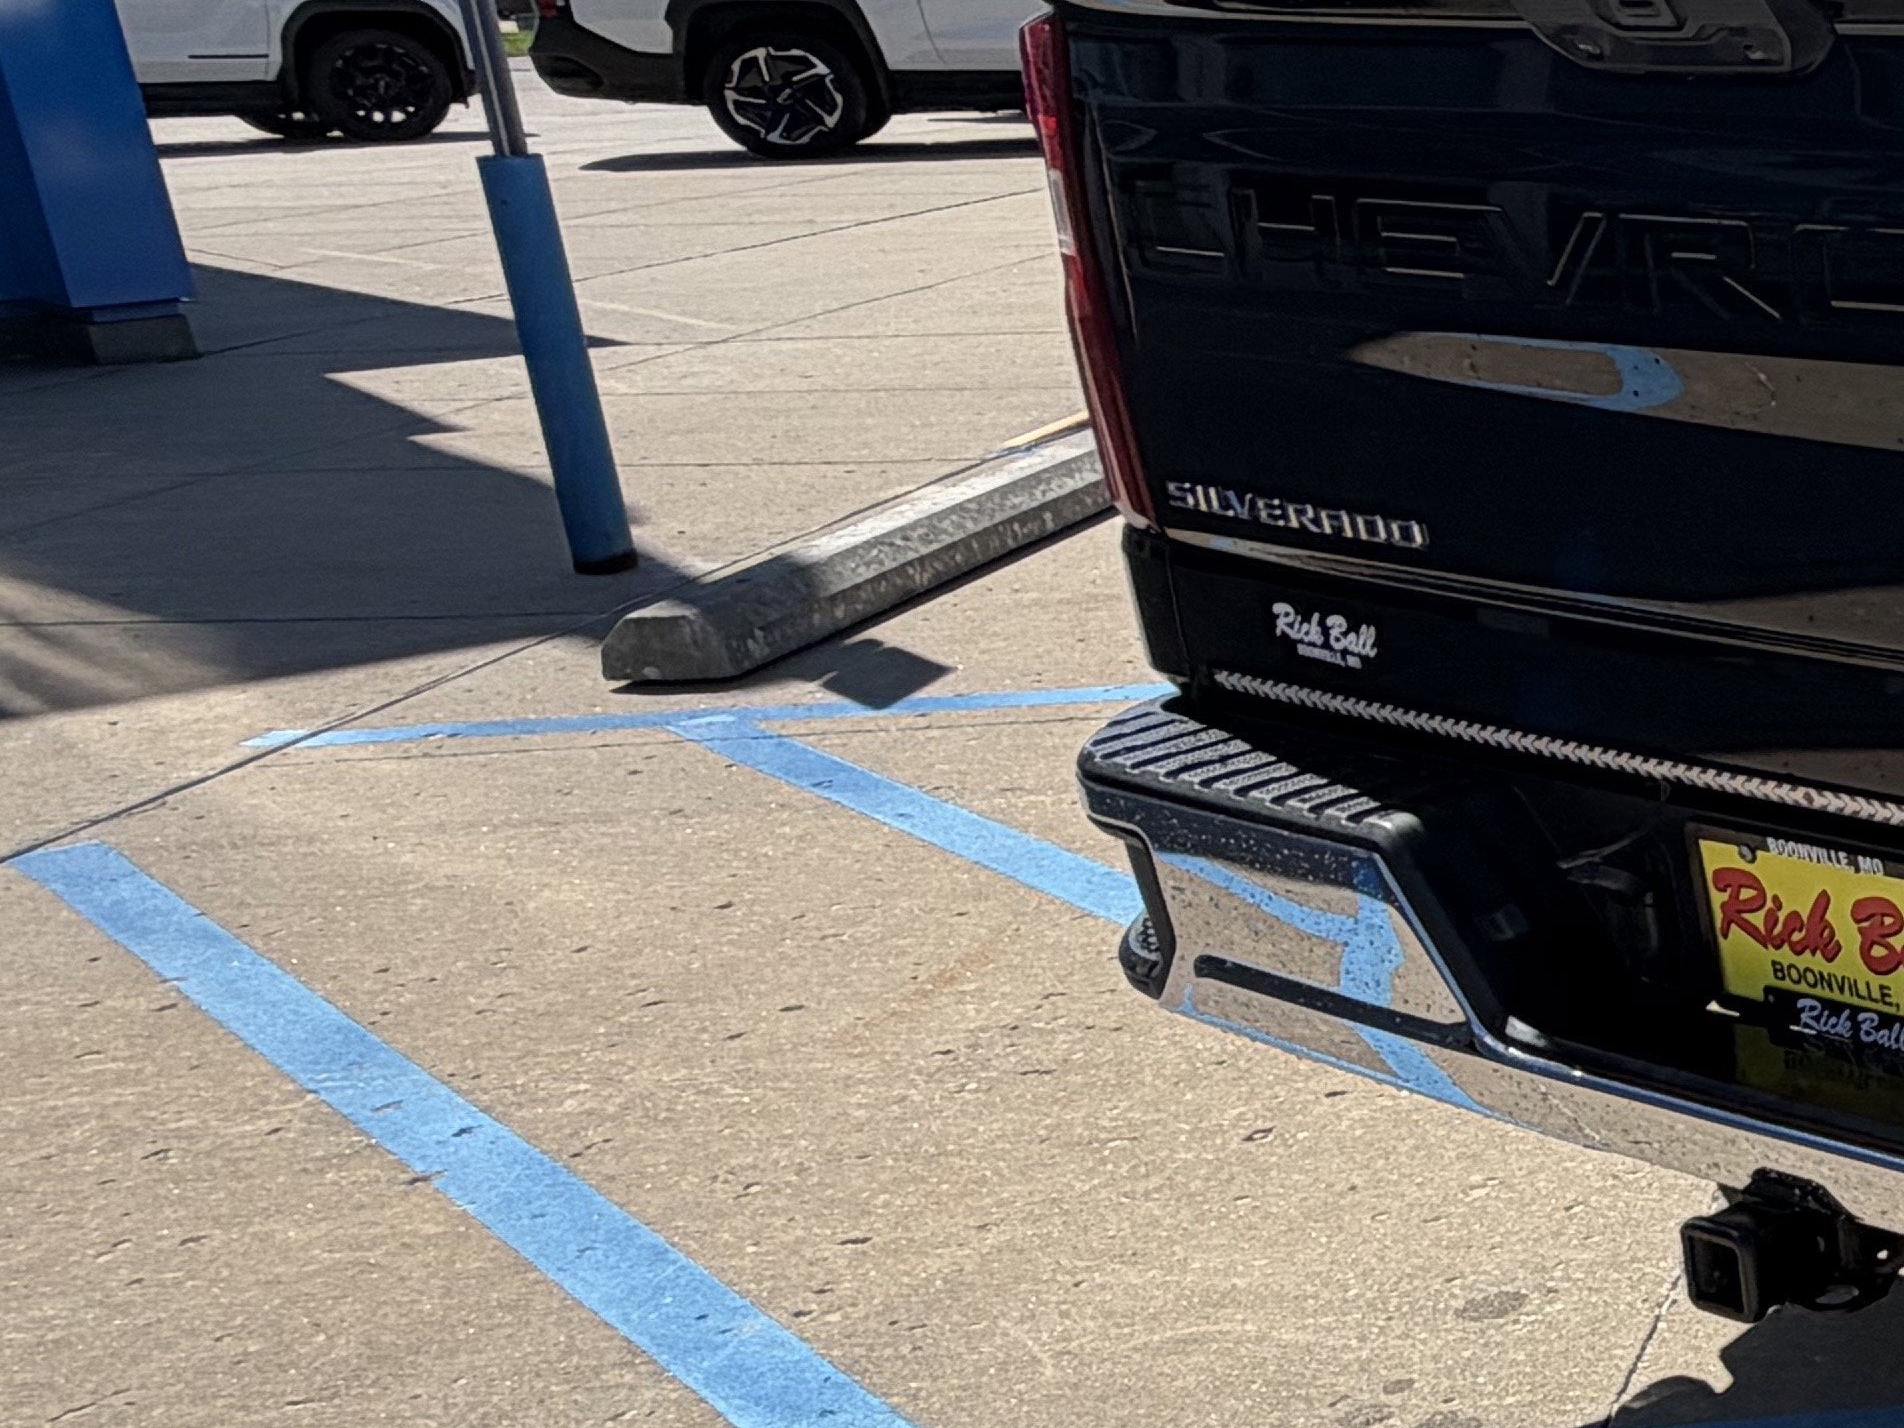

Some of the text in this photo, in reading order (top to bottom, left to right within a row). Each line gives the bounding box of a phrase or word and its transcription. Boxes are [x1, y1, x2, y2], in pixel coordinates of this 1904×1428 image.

[1166, 480, 1430, 549] SILVERADO
[1272, 602, 1324, 646] Rick
[1326, 614, 1378, 658] Ball
[1857, 854, 1884, 876] MO
[1711, 866, 1842, 964] Rick
[1770, 959, 1902, 1013] BOONVILLE,
[1796, 998, 1853, 1038] Rick
